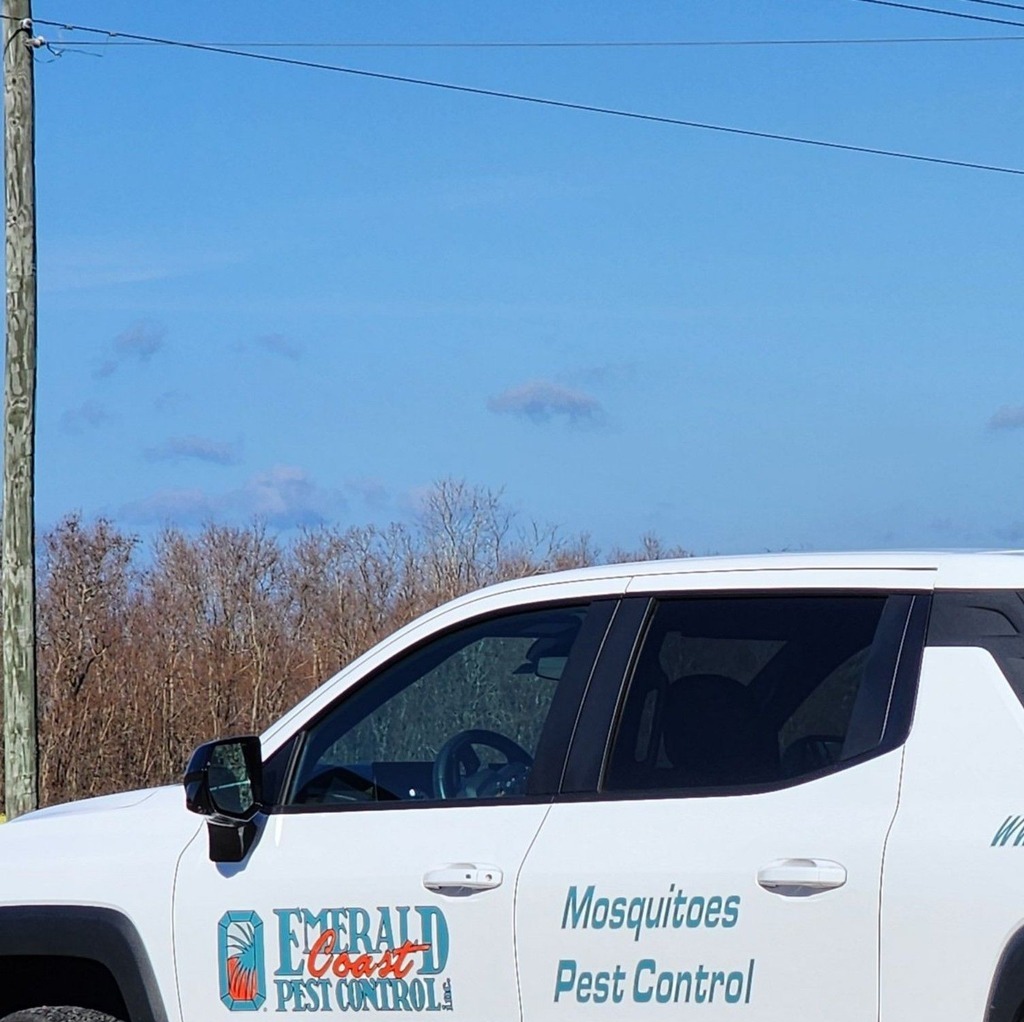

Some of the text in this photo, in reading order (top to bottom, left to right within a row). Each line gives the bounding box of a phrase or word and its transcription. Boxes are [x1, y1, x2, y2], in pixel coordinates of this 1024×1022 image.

[561, 883, 741, 942] Mosquitoes
[272, 905, 449, 976] EMERALD
[307, 928, 431, 978] Coast
[273, 977, 442, 1012] PEST CONTROL
[553, 958, 755, 1004] Pest Control
